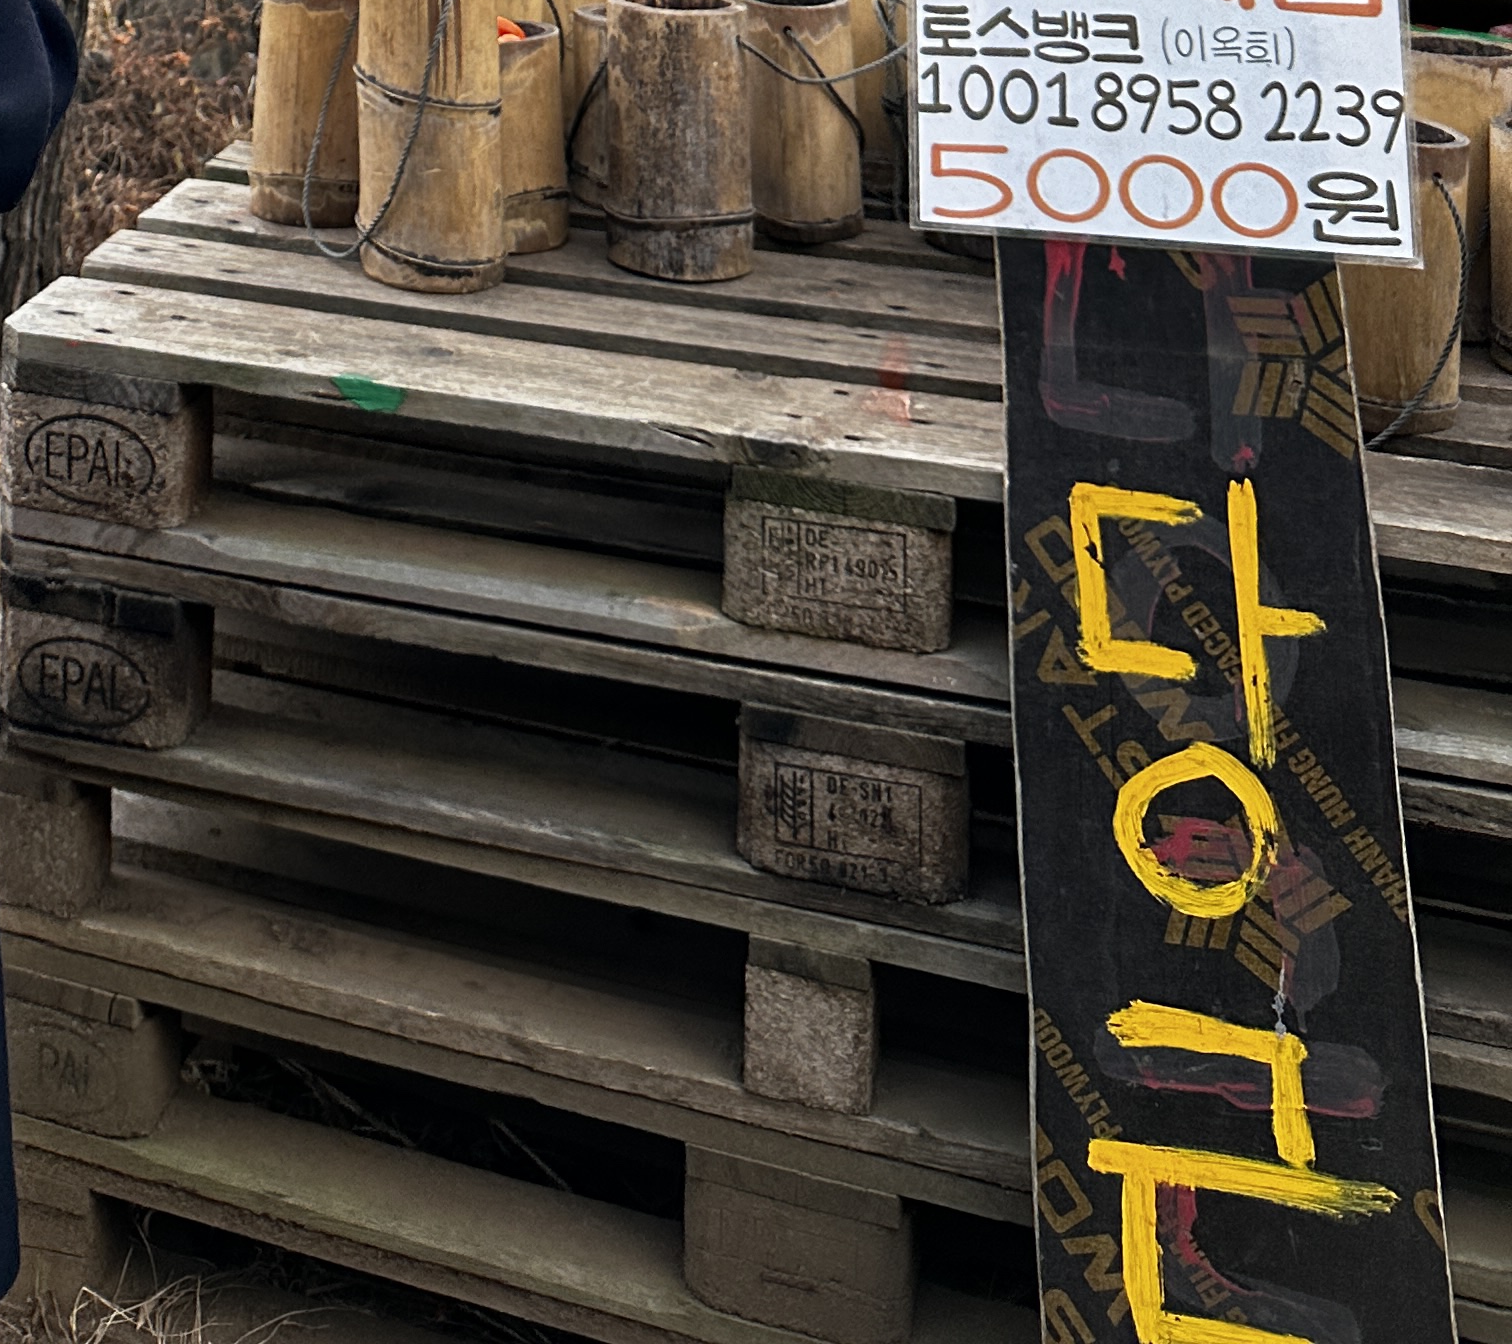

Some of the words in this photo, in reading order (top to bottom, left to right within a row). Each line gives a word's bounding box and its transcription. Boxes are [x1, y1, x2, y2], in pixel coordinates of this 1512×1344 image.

[919, 4, 1144, 64] 토스뱅크
[1260, 81, 1405, 154] 2239
[1286, 747, 1357, 829] HUNG
